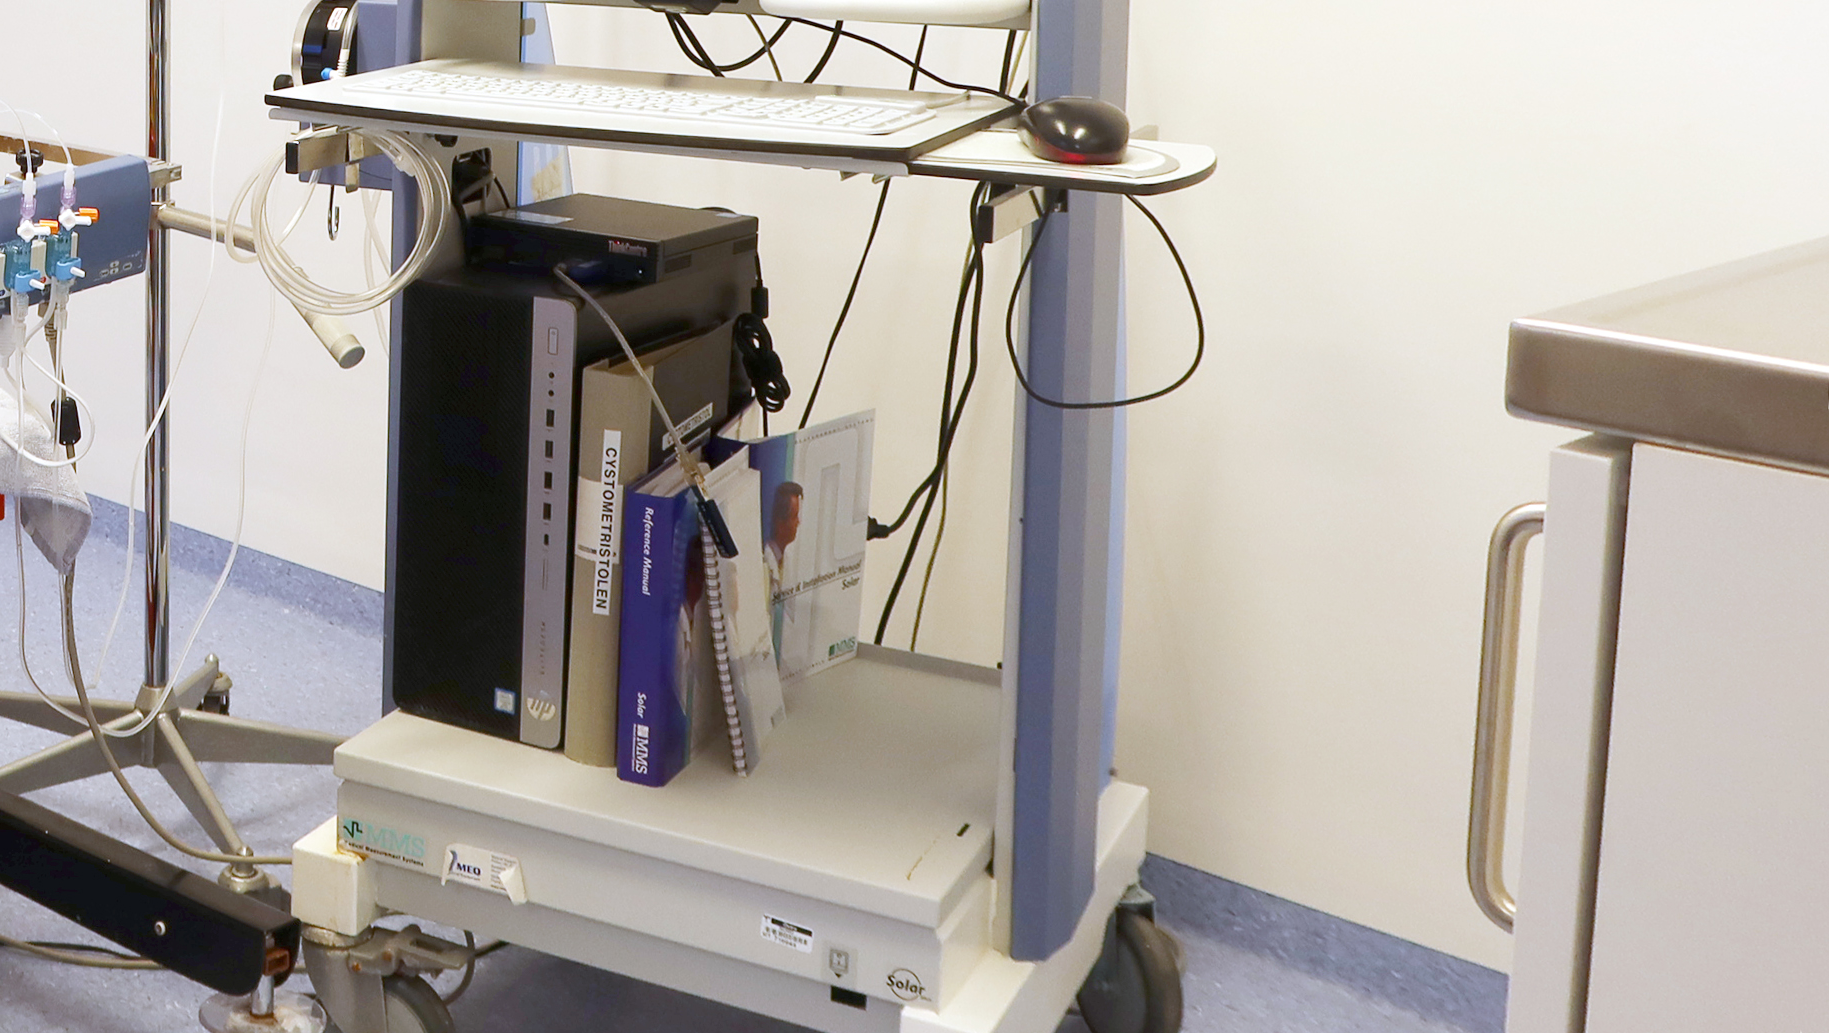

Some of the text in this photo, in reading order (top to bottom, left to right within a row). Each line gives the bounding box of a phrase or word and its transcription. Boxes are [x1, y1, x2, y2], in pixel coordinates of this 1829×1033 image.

[595, 446, 618, 609] CYSTOMETRISTOLEN
[641, 506, 655, 596] Reference Manual
[838, 560, 861, 575] Manual
[841, 577, 860, 590] Solar
[637, 692, 647, 719] Solar
[635, 737, 649, 775] MMS
[364, 823, 426, 858] MMS
[886, 974, 926, 995] Solar
